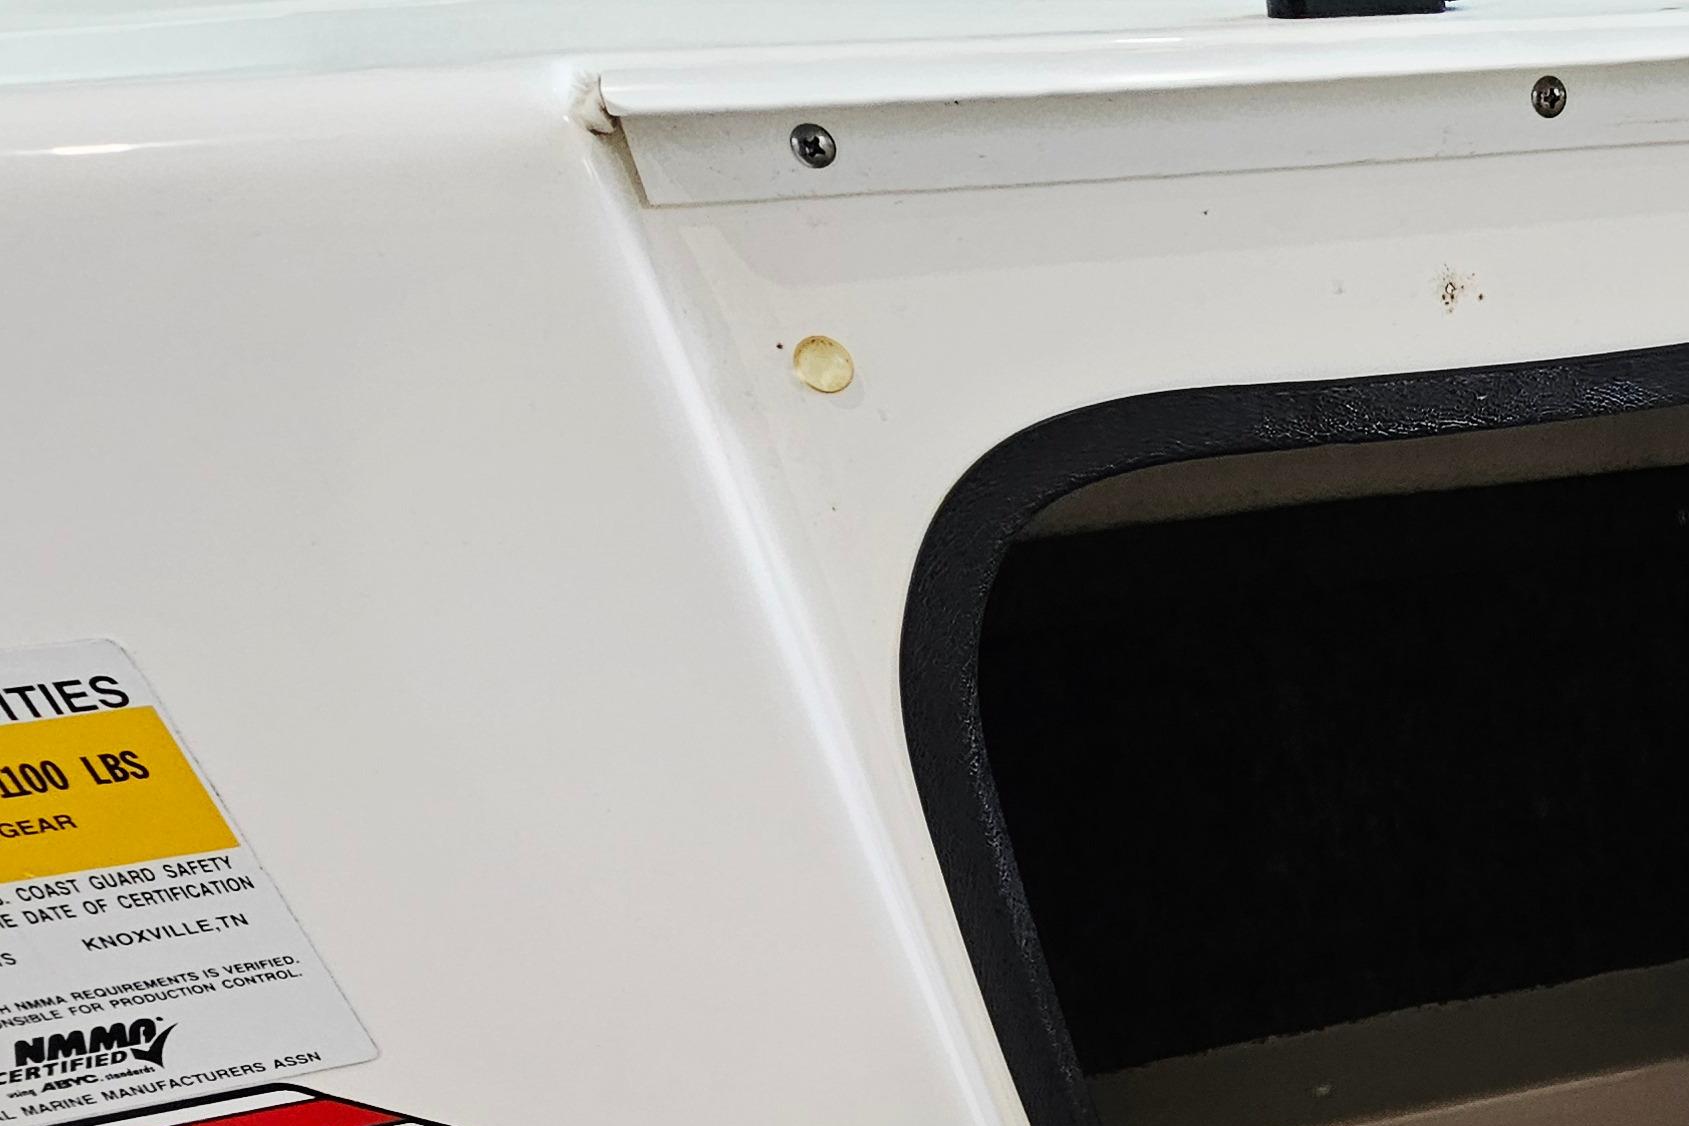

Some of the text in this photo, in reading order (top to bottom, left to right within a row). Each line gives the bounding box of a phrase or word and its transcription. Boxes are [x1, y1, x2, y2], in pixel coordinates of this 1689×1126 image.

[80, 750, 150, 786] LBS
[14, 855, 233, 903] COAST GUARD SAFETY
[21, 875, 256, 925] DATE OF CERTIFICATION
[13, 995, 68, 1012] NMMA
[69, 971, 200, 1001] REQUIREMENTS
[201, 967, 221, 979] IS
[67, 1002, 105, 1016] FOR
[108, 982, 217, 1009] PRODUCTION
[14, 1018, 157, 1068] NMMA
[19, 1051, 322, 1117] MARINE MANUFACTURERS ASSN
